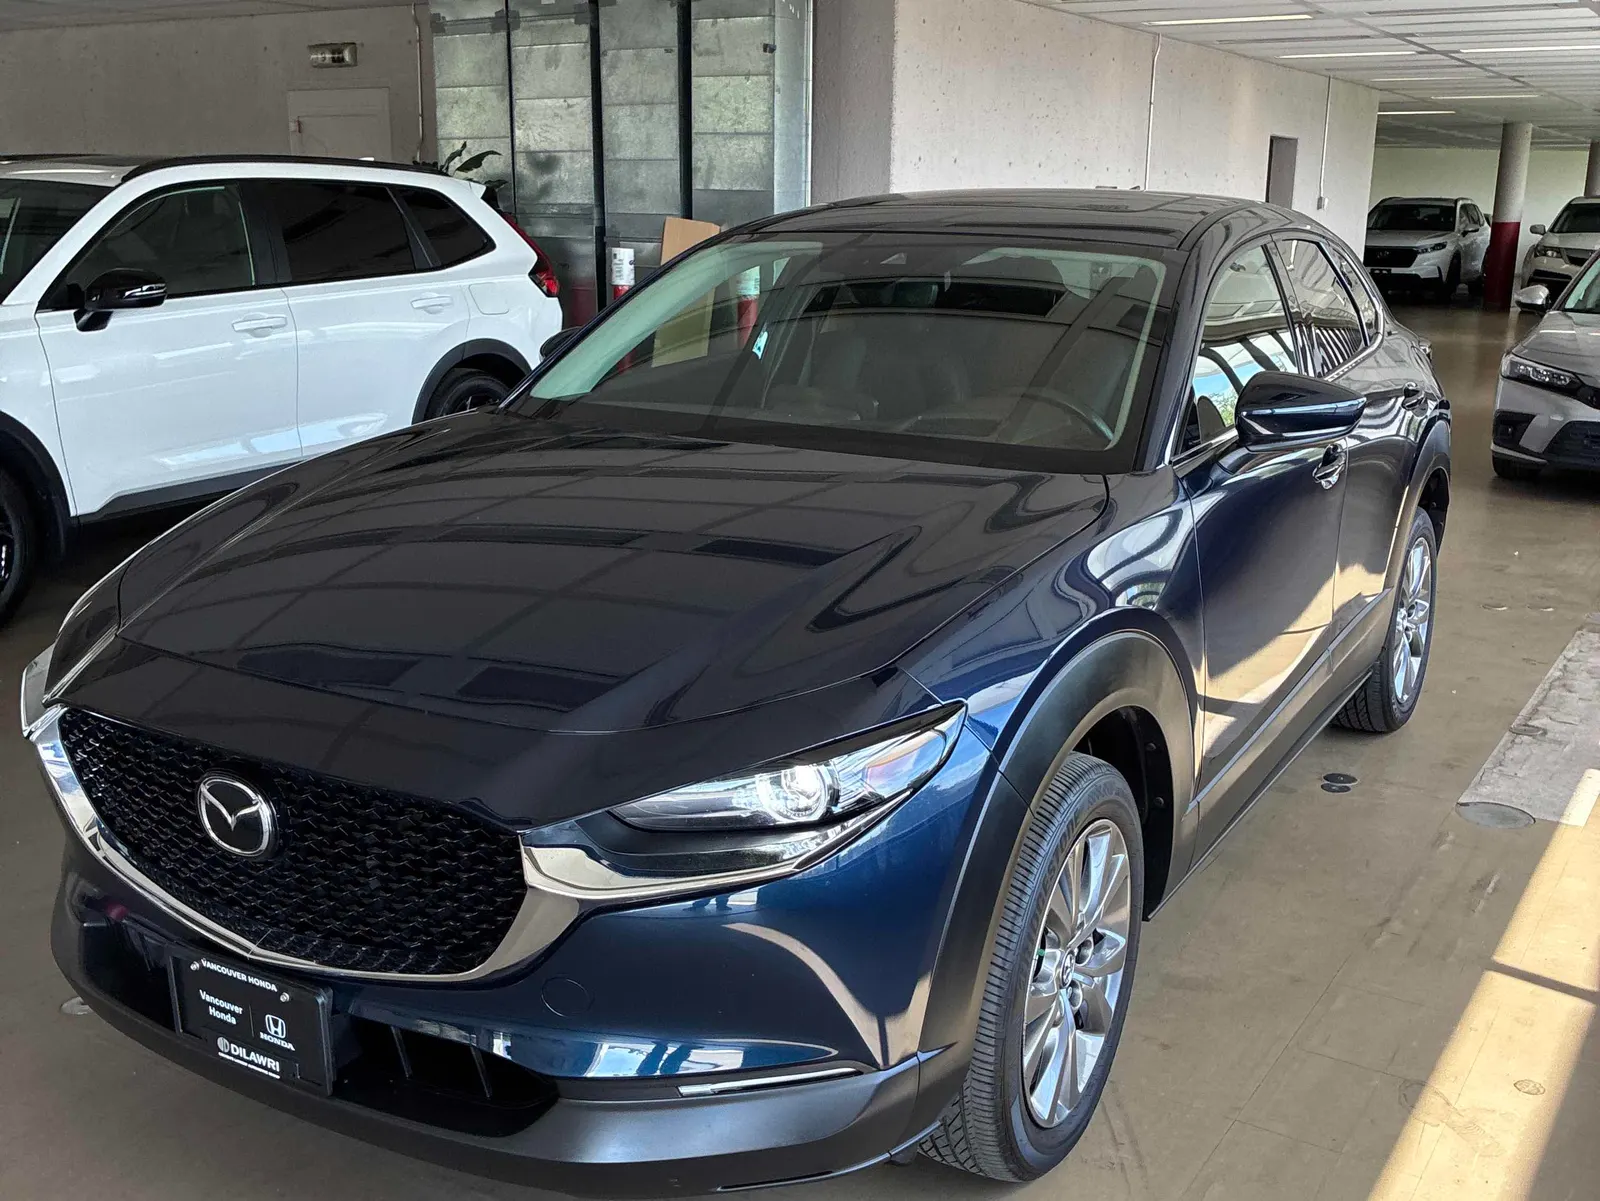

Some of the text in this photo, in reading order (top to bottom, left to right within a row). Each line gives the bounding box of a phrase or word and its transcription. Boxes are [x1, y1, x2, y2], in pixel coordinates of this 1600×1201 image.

[201, 957, 278, 992] VANCOUVER HONDA
[199, 989, 243, 1015] Vancouver
[209, 1005, 237, 1025] Honda
[259, 1031, 296, 1051] HONDA
[230, 1043, 280, 1073] DILAWRI
